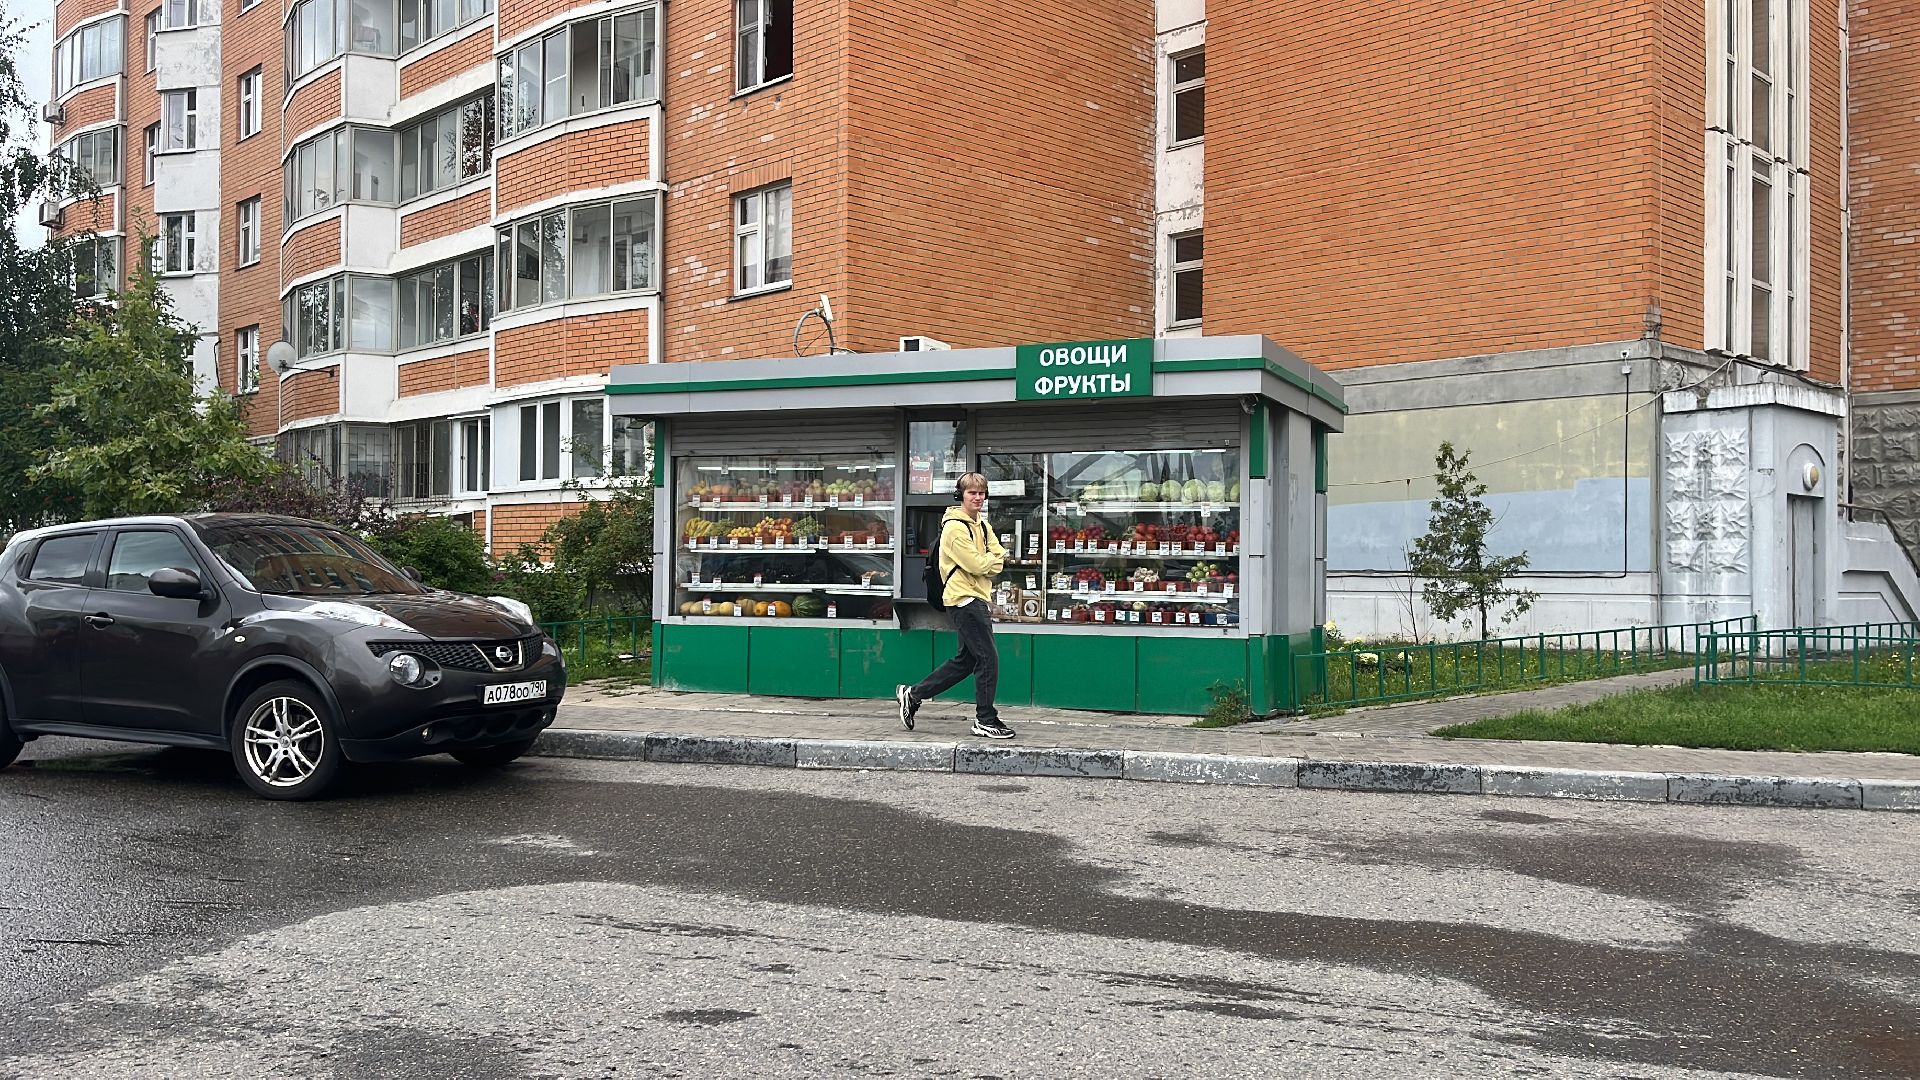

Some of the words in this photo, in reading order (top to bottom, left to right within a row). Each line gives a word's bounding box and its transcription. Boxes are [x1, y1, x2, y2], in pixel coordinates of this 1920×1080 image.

[1039, 344, 1127, 369] ОВОЩИ
[1033, 374, 1132, 395] ФРУКТЫ
[531, 681, 544, 693] 790
